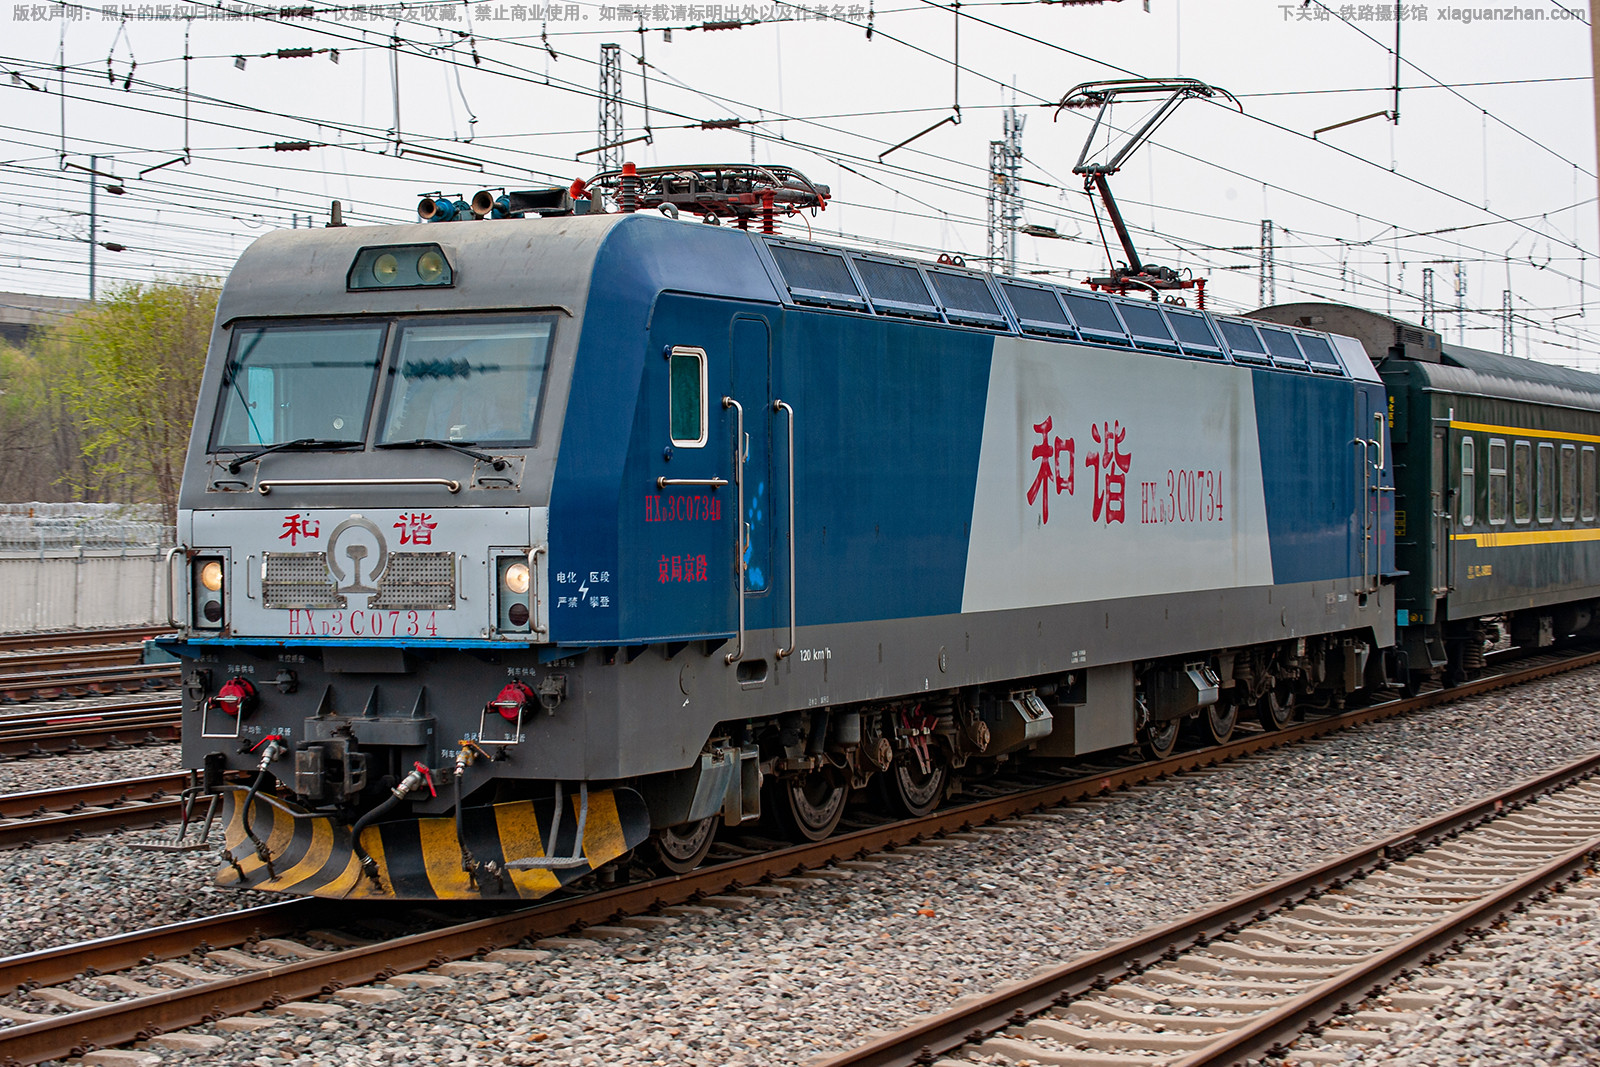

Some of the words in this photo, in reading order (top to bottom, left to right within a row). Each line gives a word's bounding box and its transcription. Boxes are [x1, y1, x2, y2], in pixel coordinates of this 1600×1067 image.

[1027, 415, 1132, 524] 和谐
[278, 513, 321, 547] 和
[392, 512, 438, 546] 谐
[657, 553, 708, 584] 京局京段
[288, 609, 438, 637] HXD3C0734
[799, 649, 812, 662] 120
